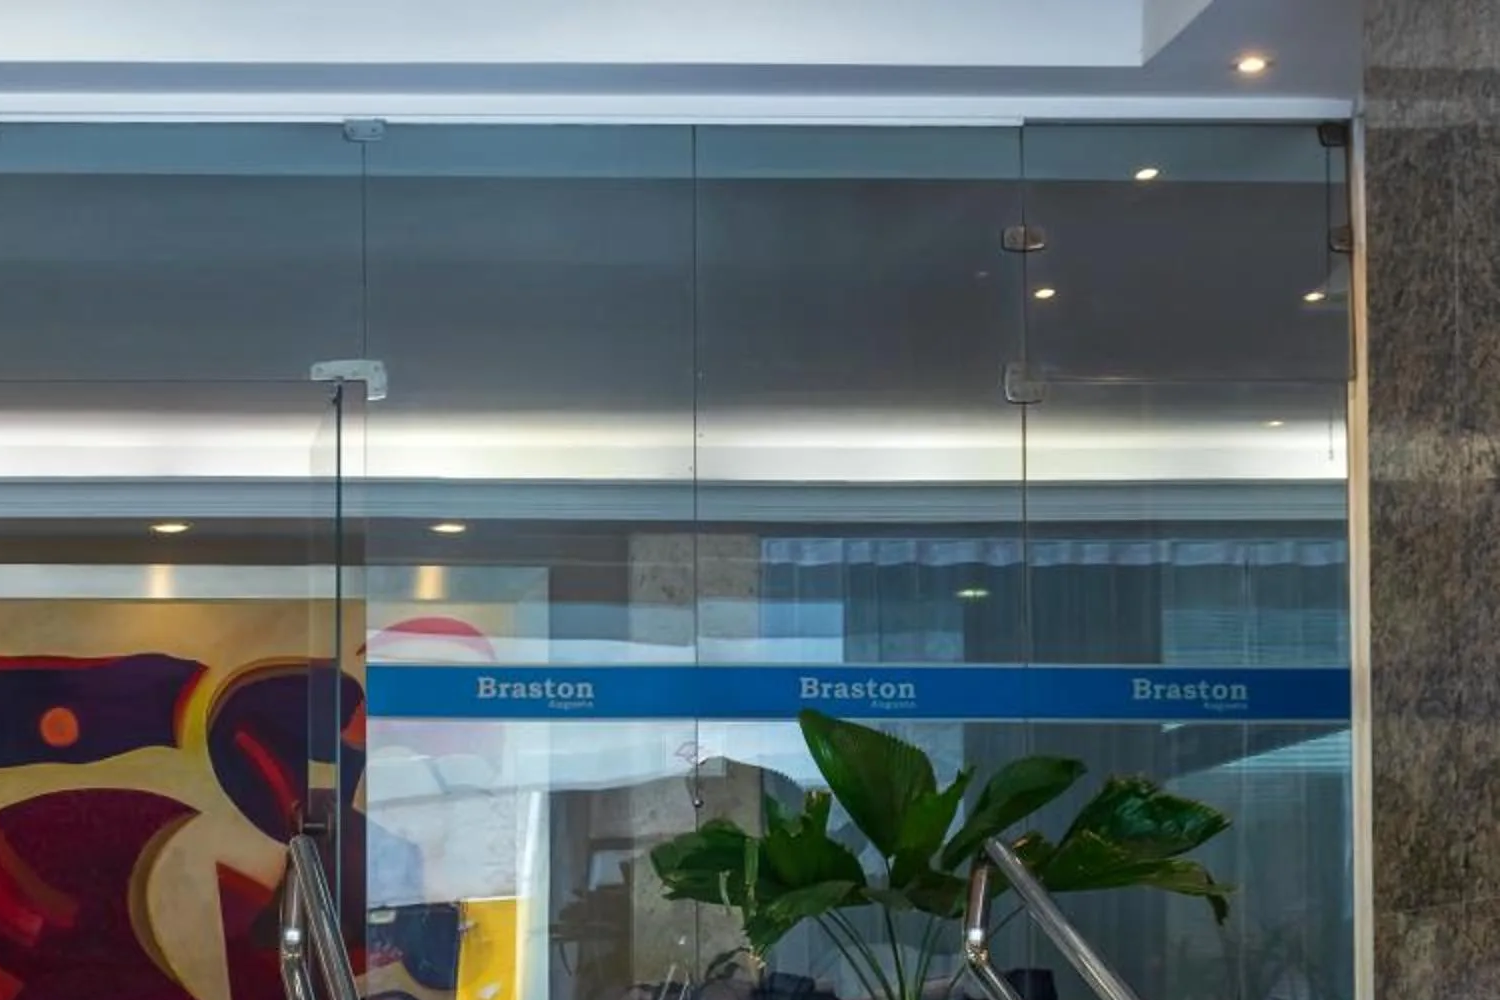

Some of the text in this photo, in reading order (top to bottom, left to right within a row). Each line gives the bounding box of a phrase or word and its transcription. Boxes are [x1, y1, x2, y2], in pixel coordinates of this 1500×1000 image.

[477, 676, 595, 698] Braston
[799, 676, 916, 698] Braston
[1132, 678, 1248, 700] Braston
